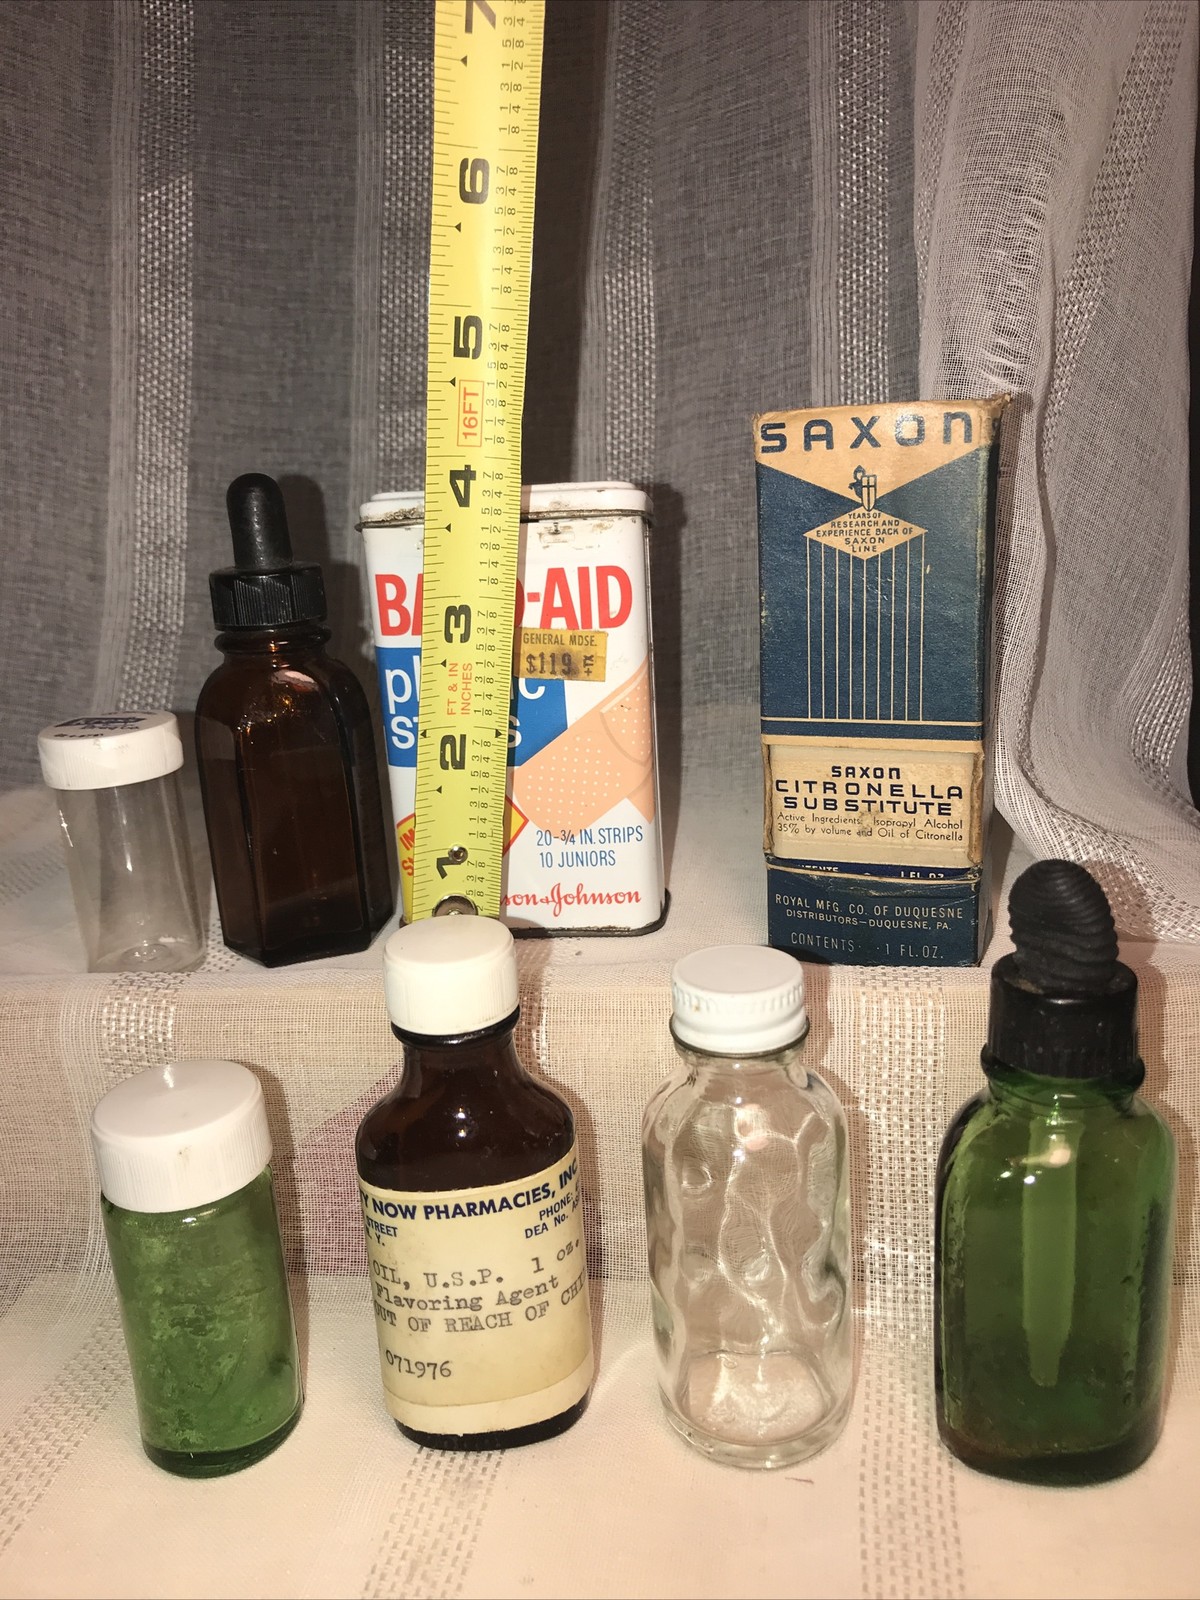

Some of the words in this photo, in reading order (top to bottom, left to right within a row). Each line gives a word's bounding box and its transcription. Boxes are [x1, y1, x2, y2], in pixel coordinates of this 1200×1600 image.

[459, 157, 490, 205] 6
[453, 315, 483, 360] 5
[463, 386, 479, 440] 16FT
[449, 464, 476, 508] 4
[816, 528, 871, 537] EXPERIENCE
[875, 528, 899, 536] BACK
[902, 527, 914, 535] OF
[830, 520, 879, 528] RESEARCH
[844, 536, 885, 545] SAXON
[852, 545, 877, 553] LINE
[444, 604, 472, 644] 3
[523, 632, 565, 646] GENERAL
[569, 634, 598, 647] MDSE.
[448, 662, 459, 677] IN
[448, 683, 458, 692] &
[460, 662, 473, 716] INCHES
[446, 698, 457, 716] FT
[440, 734, 467, 771] 2
[775, 779, 963, 800] CITRONELLA
[783, 796, 952, 817] SUBSTITUTE
[777, 811, 805, 822] Active
[873, 815, 916, 829] Isopropyl
[924, 818, 963, 830] Alcohol
[598, 825, 643, 845] STRIPS
[777, 822, 800, 835] 35%
[804, 824, 816, 835] by
[820, 825, 852, 836] volume
[877, 827, 894, 837] Oil
[900, 829, 910, 838] of
[915, 829, 963, 841] Citronella
[539, 851, 553, 868] 10
[557, 850, 616, 868] JUNIORS
[551, 882, 641, 917] Johnson
[775, 893, 810, 909] ROYAL
[816, 899, 842, 913] MFG.
[849, 903, 868, 915] CO.
[873, 905, 889, 916] OF
[894, 906, 963, 919] DUQUESNE
[936, 921, 951, 930] PA.
[791, 931, 854, 953] CONTENTS
[371, 1197, 417, 1220] NOW
[423, 1182, 556, 1221] PHARMACIES,
[539, 1191, 574, 1221] PHONE:
[524, 1222, 549, 1239] DEA
[373, 1259, 411, 1290] OIL,
[375, 1281, 483, 1312] Flavoring
[495, 1274, 560, 1306] Agent
[407, 1316, 432, 1332] OF
[443, 1311, 513, 1332] REACH
[525, 1300, 550, 1321] OF
[385, 1349, 452, 1380] 071976
